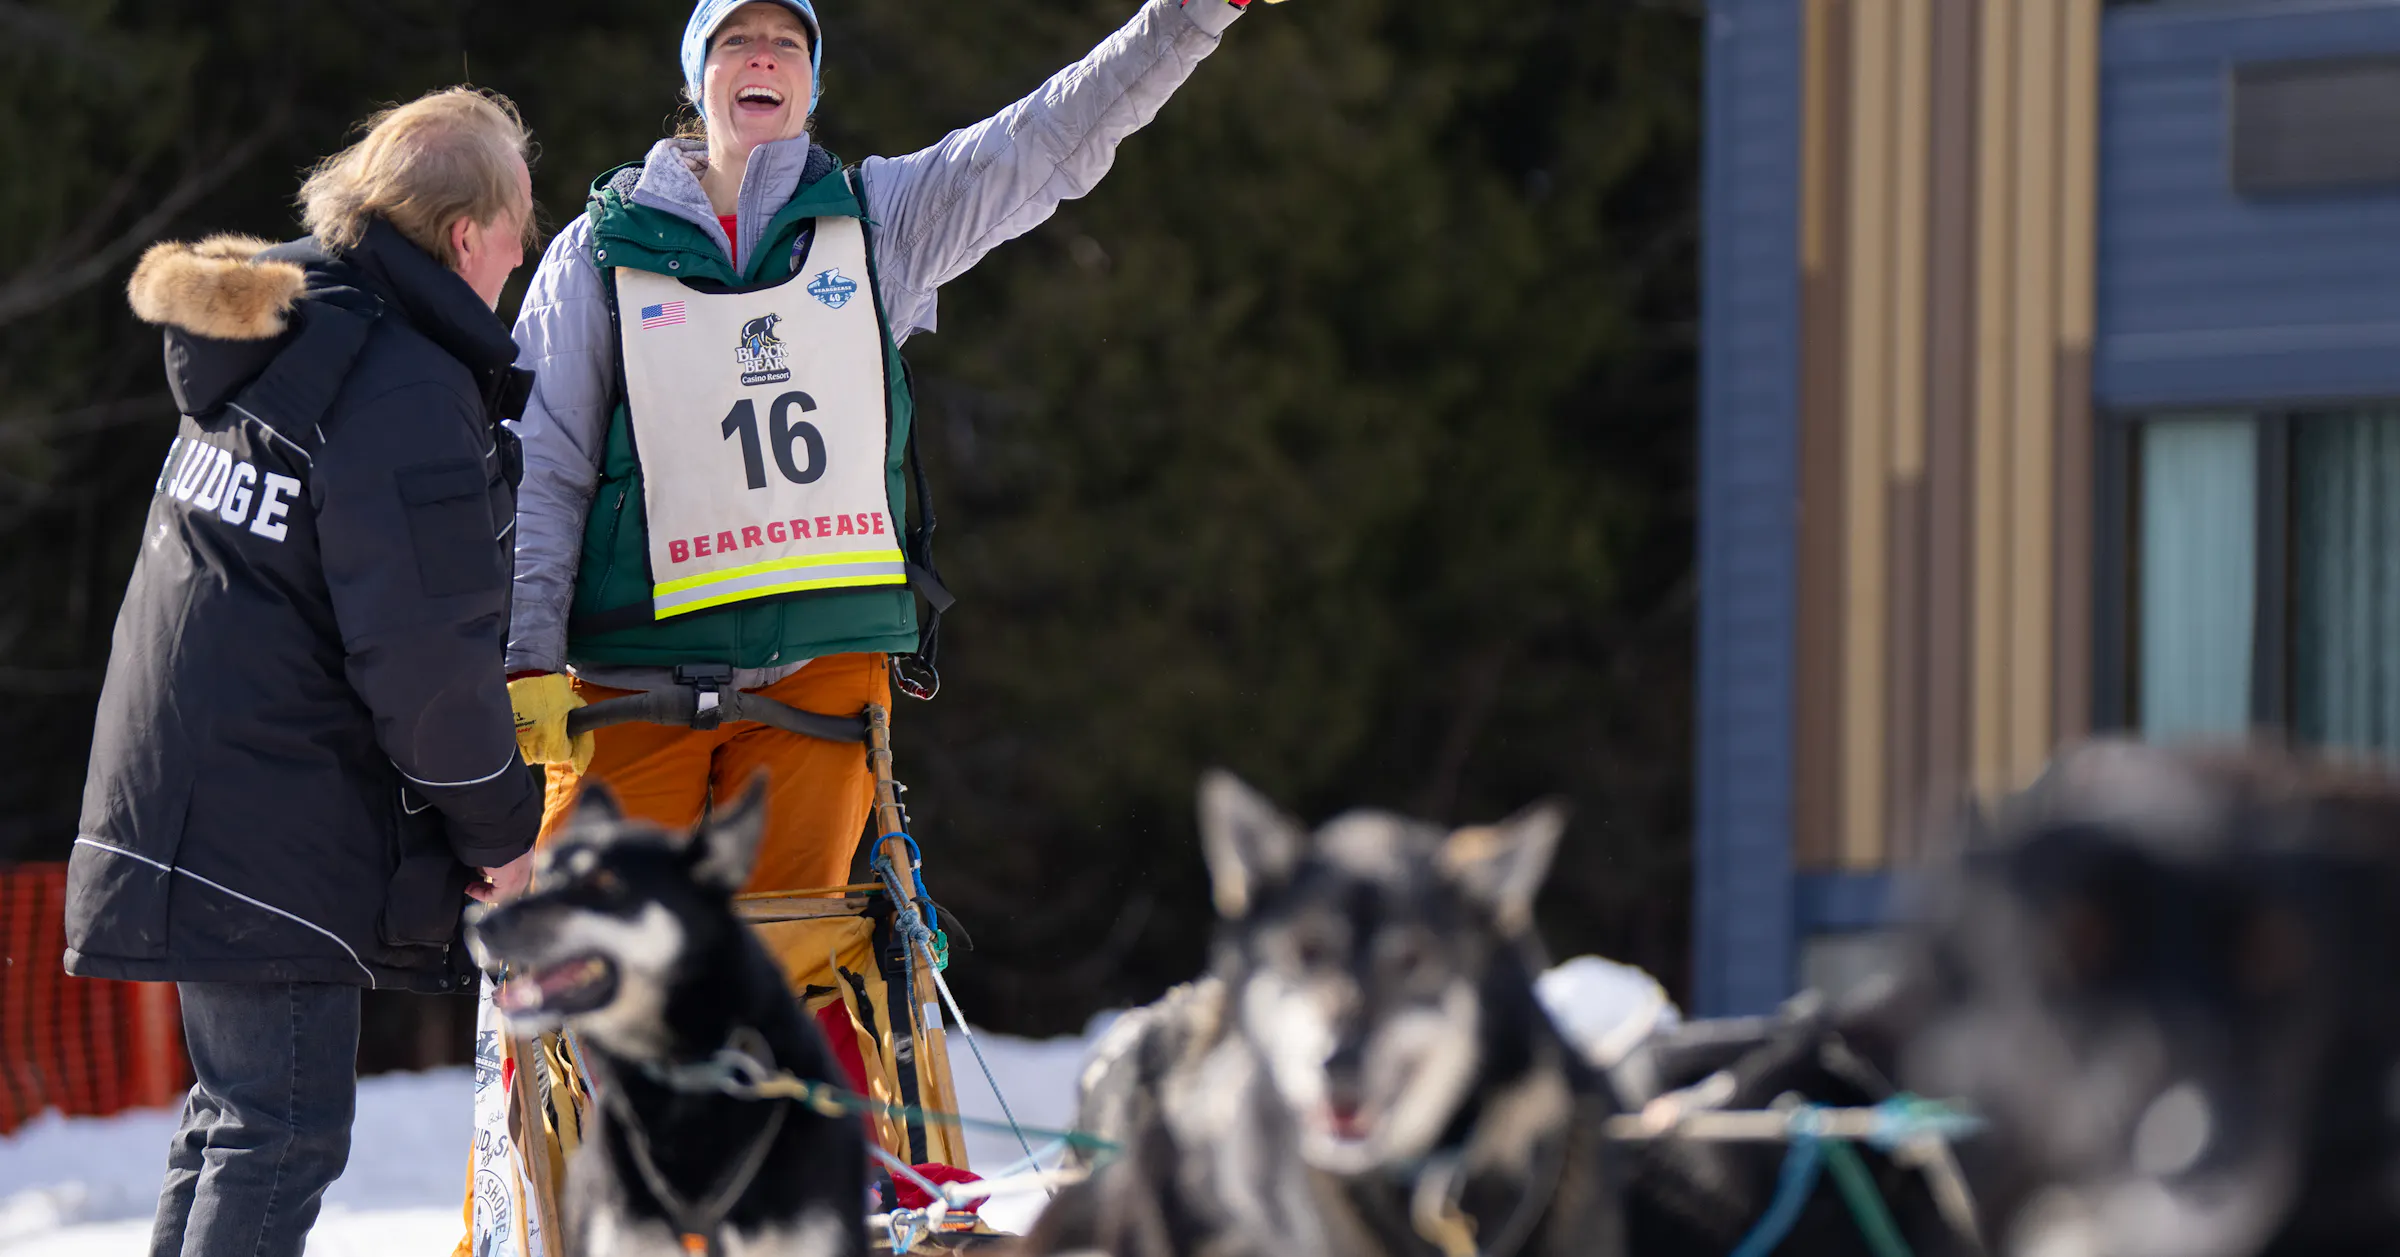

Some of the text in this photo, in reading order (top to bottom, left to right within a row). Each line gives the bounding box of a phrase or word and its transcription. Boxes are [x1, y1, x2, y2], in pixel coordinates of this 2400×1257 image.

[829, 293, 841, 302] 40
[735, 342, 789, 363] BLACK
[742, 371, 789, 384] Casino Resort
[744, 357, 786, 374] BEAR
[721, 390, 827, 490] 16
[168, 438, 301, 542] JUDGE
[669, 512, 884, 564] BEARGREASE
[475, 1127, 491, 1151] UD
[484, 1178, 506, 1236] SHORE
